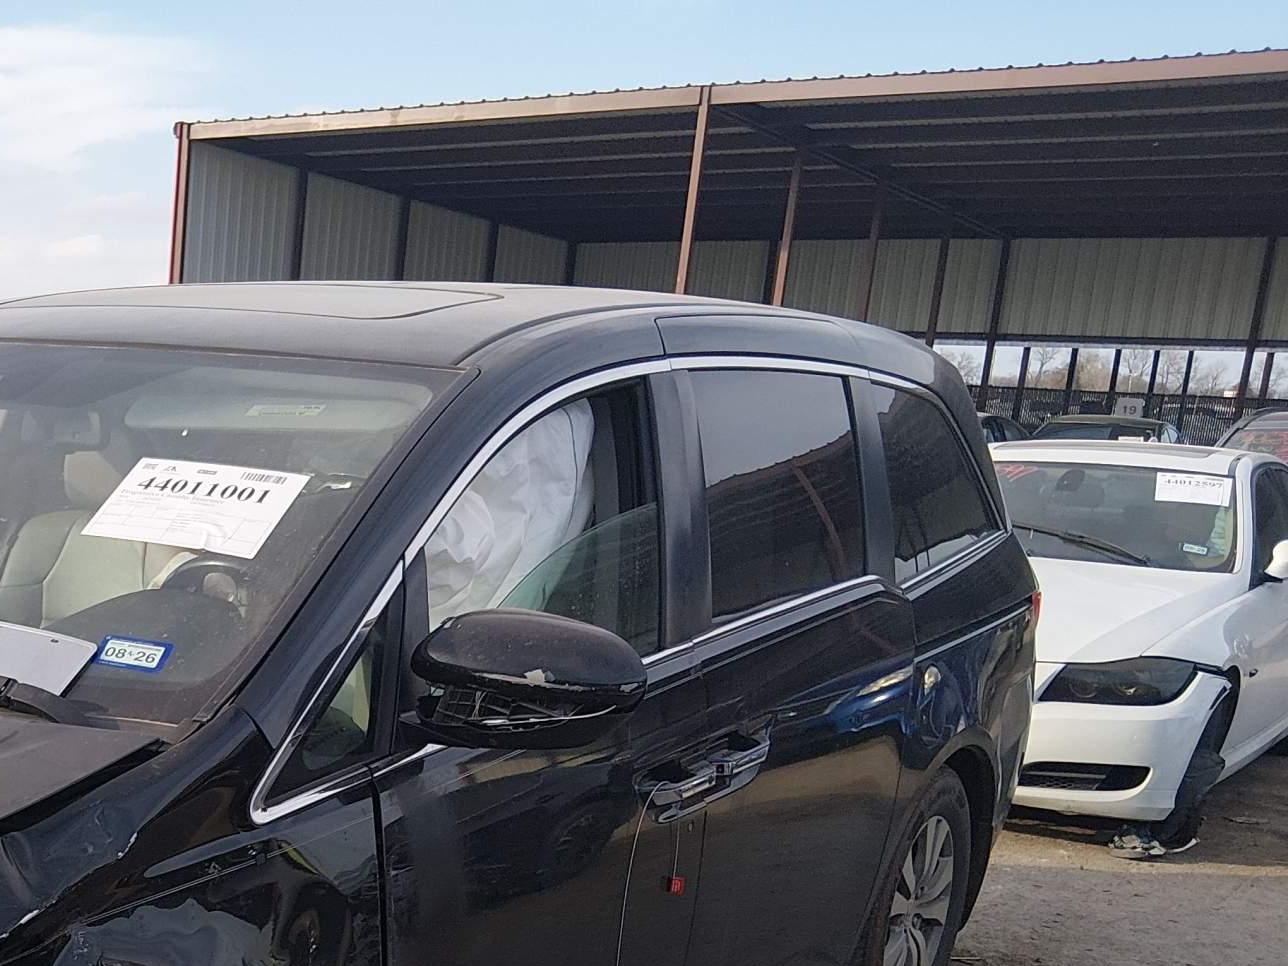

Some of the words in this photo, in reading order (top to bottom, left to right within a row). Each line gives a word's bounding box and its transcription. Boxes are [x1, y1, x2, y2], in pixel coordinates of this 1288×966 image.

[1123, 405, 1137, 415] 19
[137, 476, 272, 504] 44011001
[104, 646, 128, 659] 08
[133, 651, 158, 664] 26
